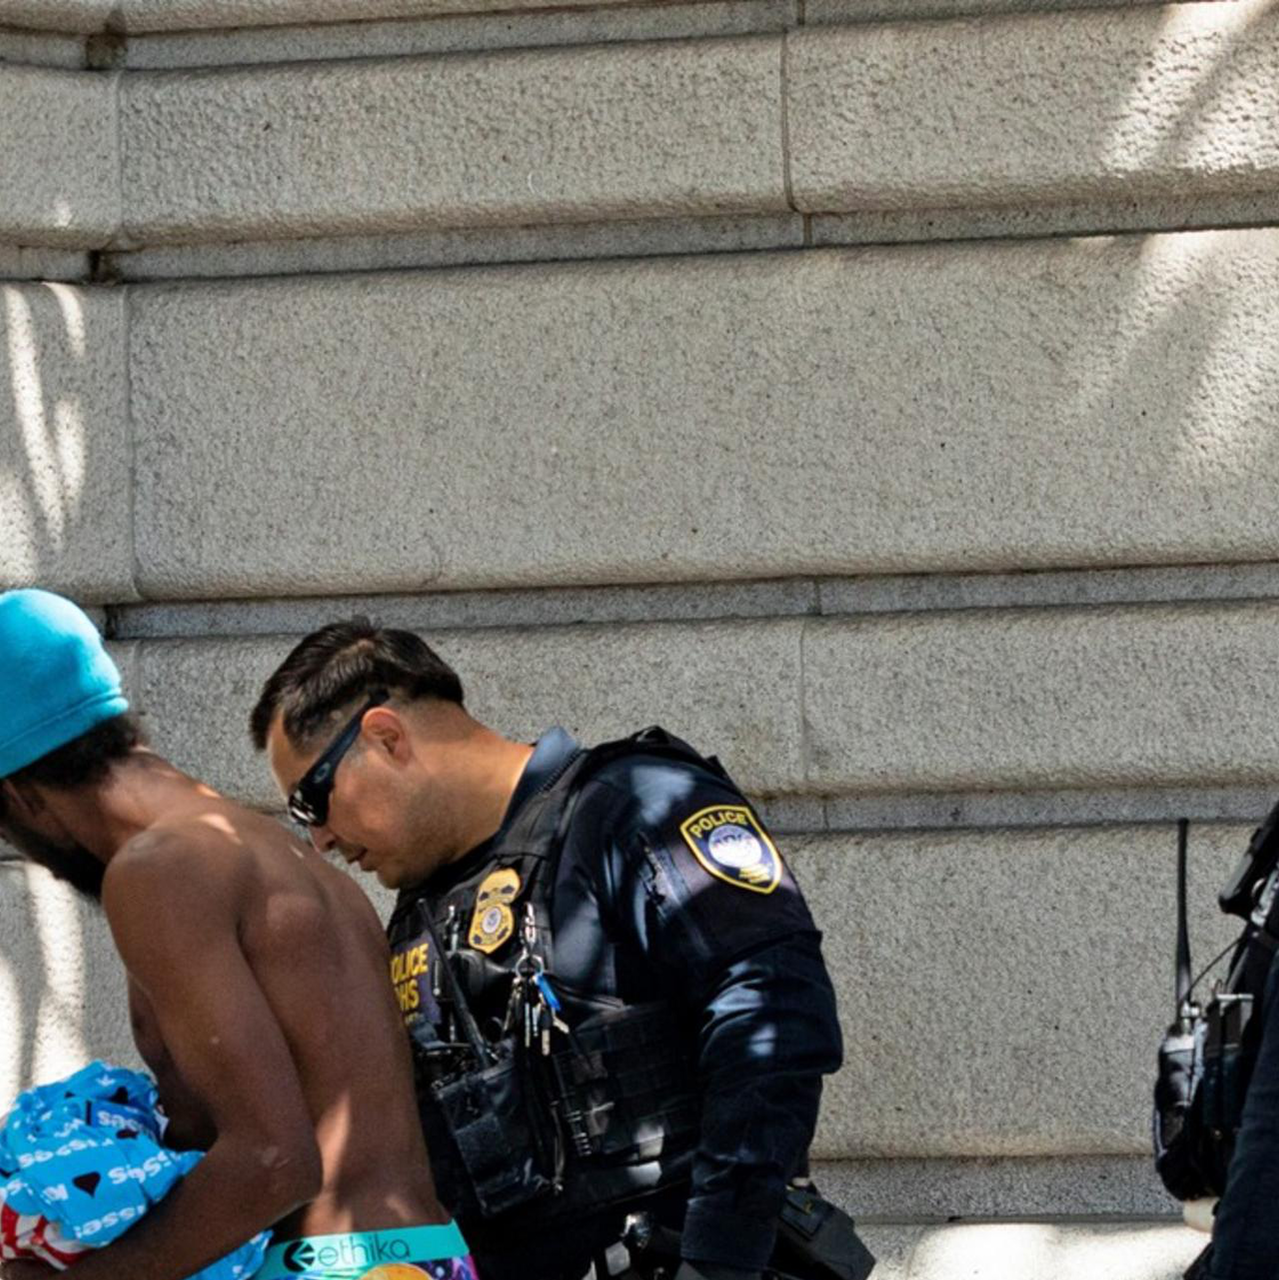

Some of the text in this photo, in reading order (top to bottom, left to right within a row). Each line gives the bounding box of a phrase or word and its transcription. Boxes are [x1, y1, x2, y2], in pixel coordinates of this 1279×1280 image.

[690, 811, 748, 839] POLICE
[391, 943, 429, 985] OLICE
[319, 1233, 411, 1267] ethika
